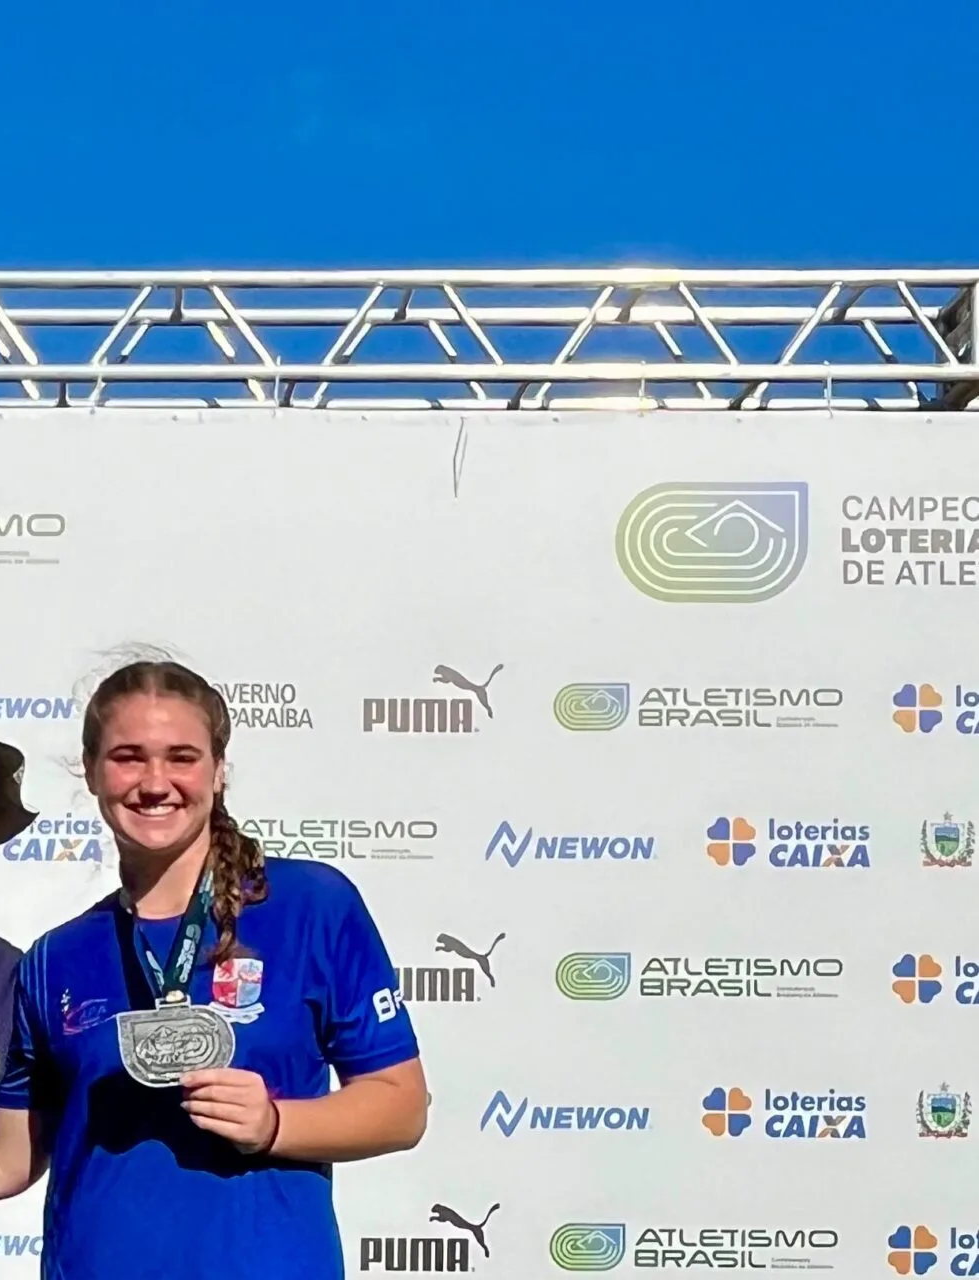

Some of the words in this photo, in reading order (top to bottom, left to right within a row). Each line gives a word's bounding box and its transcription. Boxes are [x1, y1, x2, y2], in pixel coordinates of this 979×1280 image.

[843, 560, 884, 585] DE
[895, 561, 979, 585] ATLE
[640, 688, 843, 706] ATLETISMO
[363, 698, 472, 733] PUMA
[639, 709, 771, 727] BRASIL
[240, 820, 437, 838] ATLETISMO
[769, 818, 869, 841] loterias
[3, 838, 103, 862] CAIXA
[535, 837, 654, 859] NEWON
[769, 844, 870, 867] CAIXA
[641, 958, 843, 977] ATLETISMO
[640, 978, 771, 997] BRASIL
[765, 1089, 865, 1111] loterias
[530, 1107, 649, 1130] NEWON
[765, 1115, 866, 1138] CAIXA
[636, 1229, 838, 1248] ATLETISMO
[360, 1238, 469, 1272] PUMA
[635, 1249, 766, 1268] BRASIL
